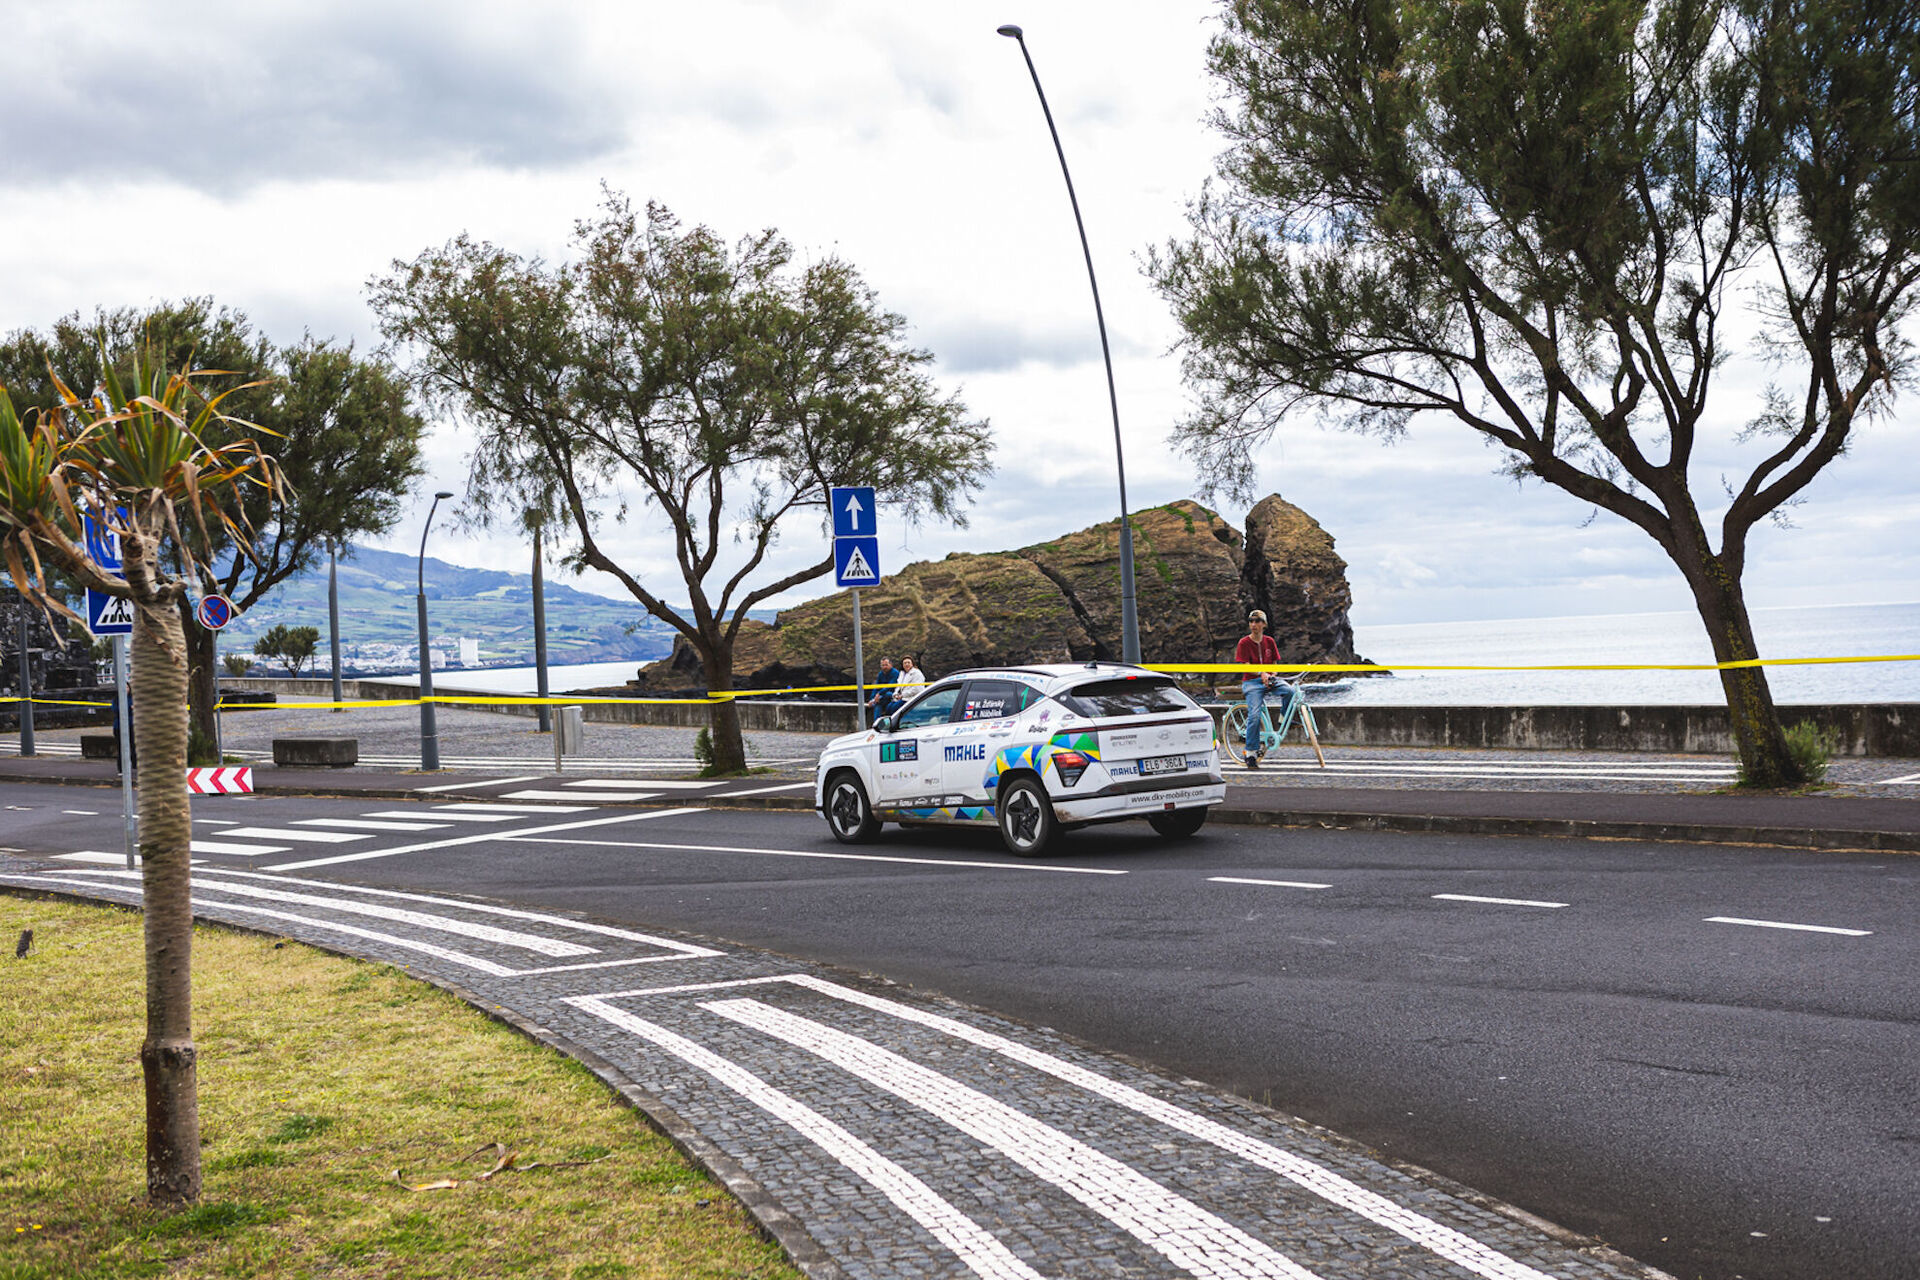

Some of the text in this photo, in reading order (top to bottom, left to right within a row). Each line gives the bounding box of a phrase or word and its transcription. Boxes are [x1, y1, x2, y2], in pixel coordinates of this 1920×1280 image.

[1020, 686, 1030, 711] 1
[944, 744, 986, 762] MAHLE
[1110, 766, 1138, 776] MAHLE
[1187, 759, 1209, 769] MAHLE
[1131, 789, 1205, 803] www.dkv-mobility.com
